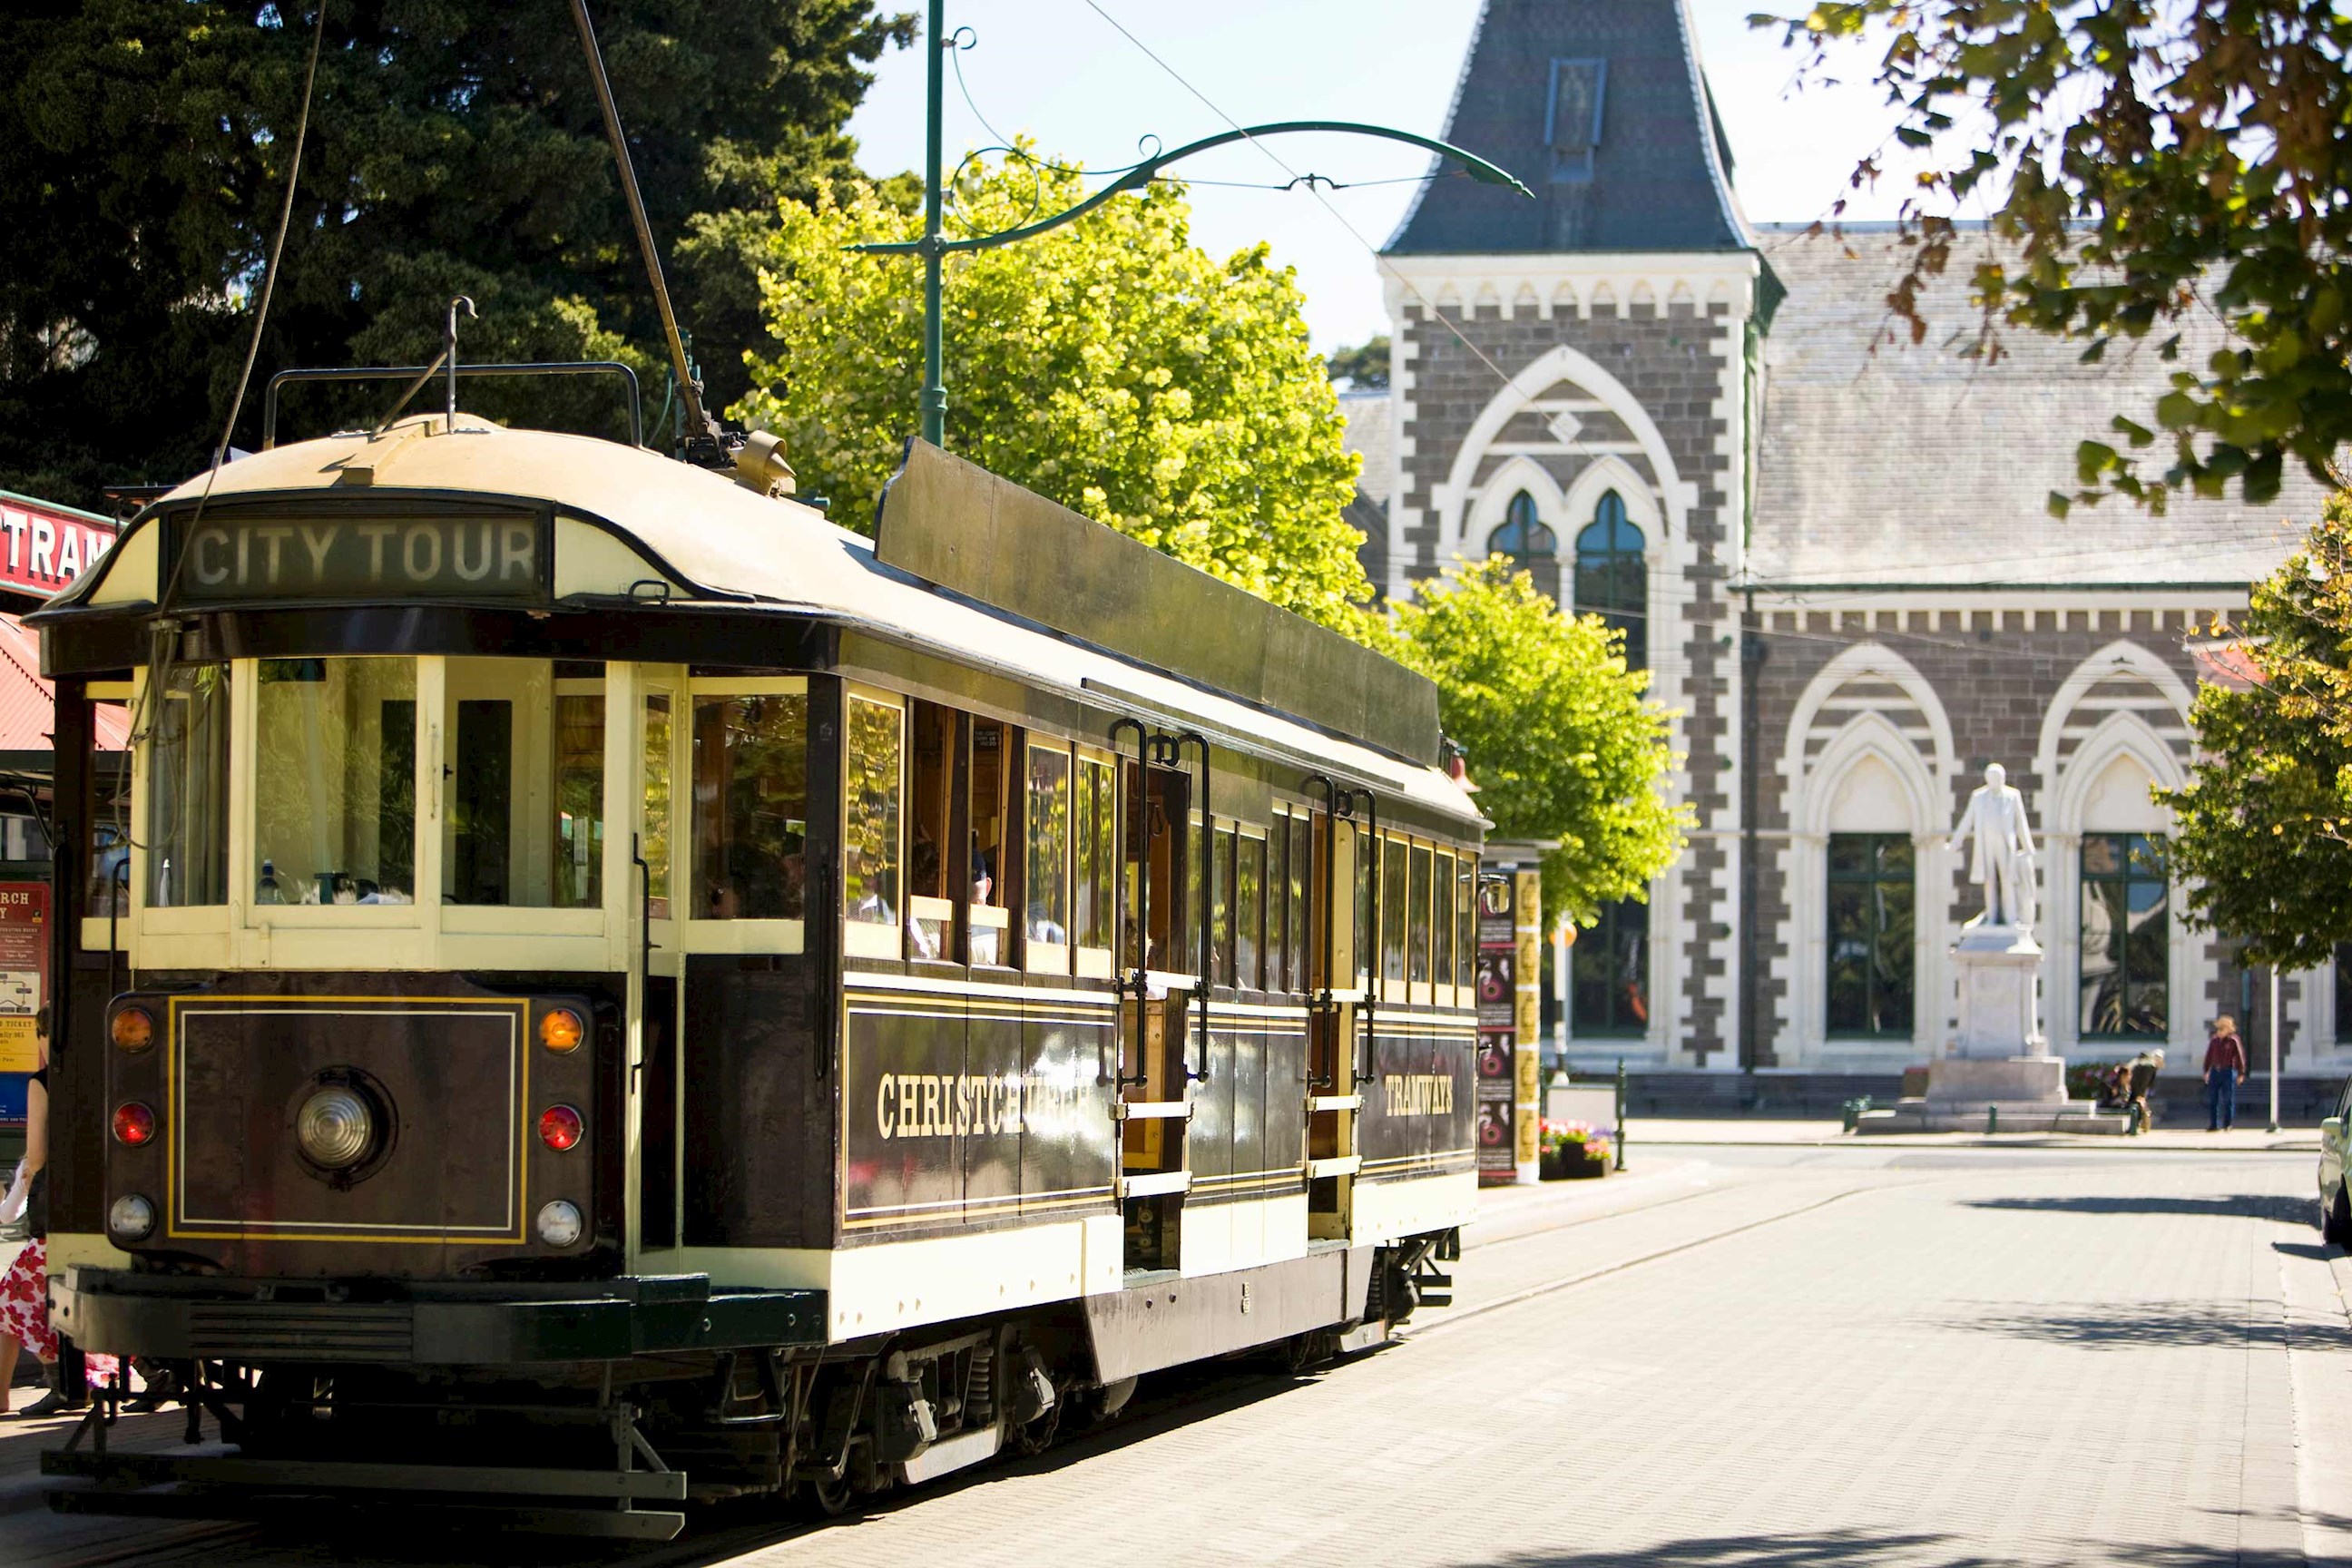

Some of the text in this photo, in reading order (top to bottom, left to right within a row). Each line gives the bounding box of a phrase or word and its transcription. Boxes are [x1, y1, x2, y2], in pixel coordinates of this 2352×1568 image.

[192, 523, 536, 586] CITY TOUR
[1385, 1074, 1454, 1117] TRAMWAYS
